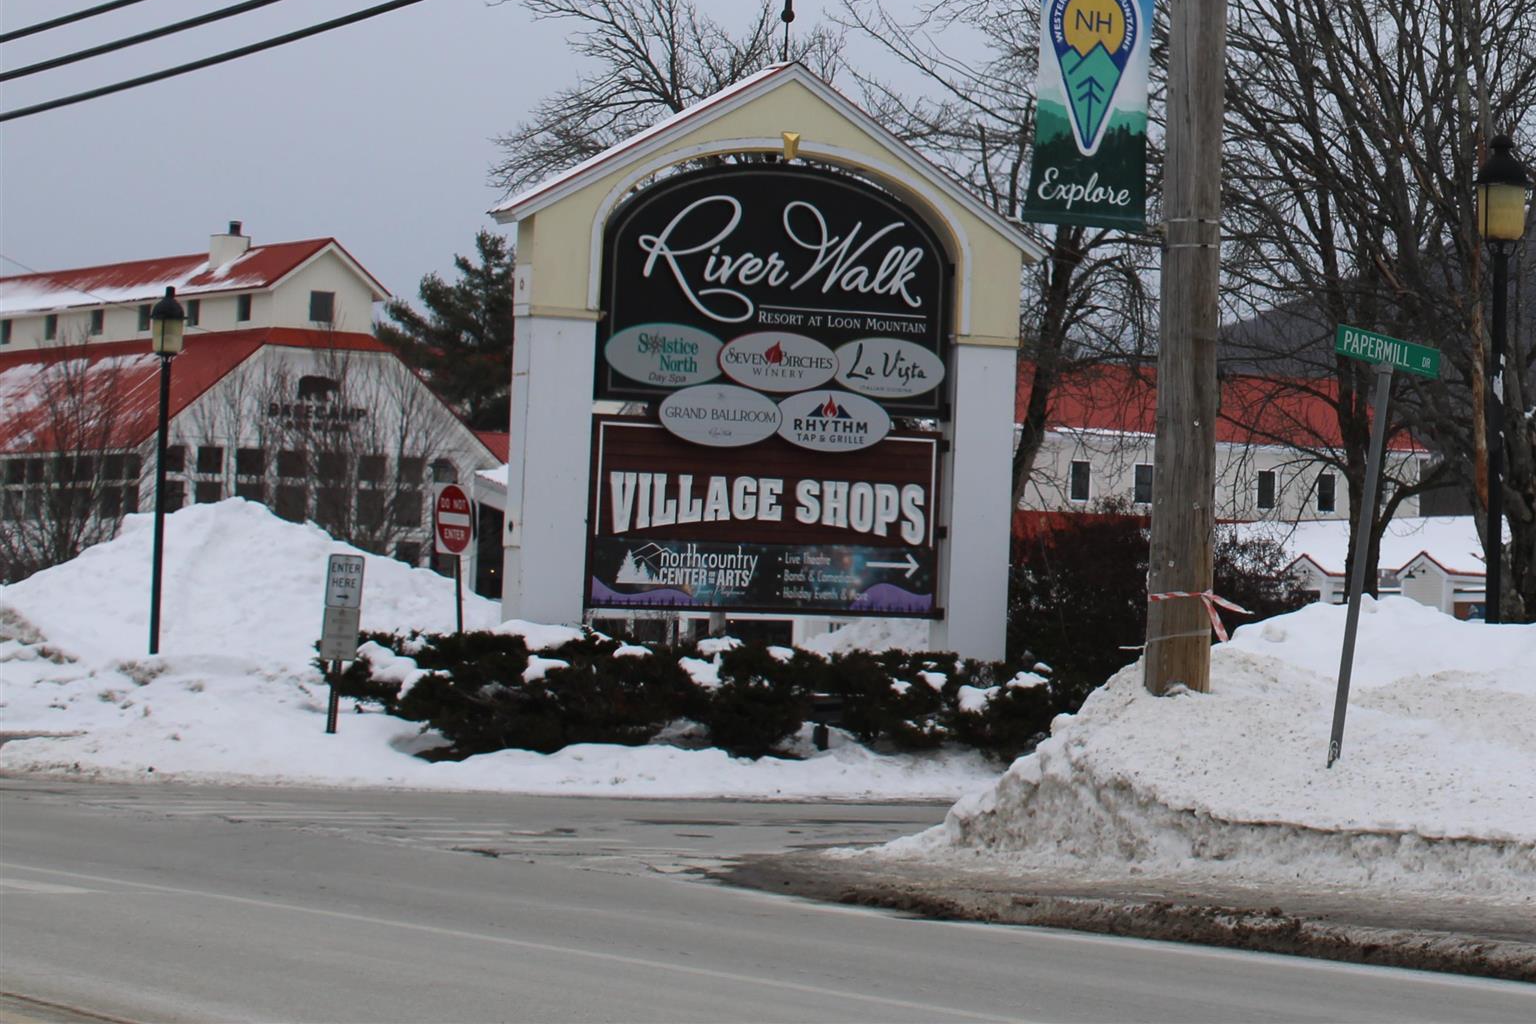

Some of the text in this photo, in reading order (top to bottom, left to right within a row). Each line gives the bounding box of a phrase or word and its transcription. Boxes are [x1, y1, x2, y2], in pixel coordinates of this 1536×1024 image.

[1075, 9, 1112, 34] NH
[1037, 167, 1131, 209] Explore
[639, 194, 923, 323] River Walk
[758, 311, 927, 333] RESORT AT LOON MOUNTAIN
[725, 343, 833, 370] SEVEN BIRCHES
[1343, 330, 1431, 369] PAPERMILL DR
[659, 353, 698, 373] North
[846, 342, 927, 386] La Vista
[648, 371, 687, 384] Day Spa
[752, 367, 804, 379] WINERY
[665, 406, 776, 423] GRAND BALLROOM
[793, 419, 868, 435] RHYTHM
[797, 434, 865, 445] TAP & GRILLE
[440, 497, 466, 510] DO NOT
[610, 471, 925, 546] VILLAGE SHOPS
[444, 528, 465, 540] ENTER
[785, 552, 800, 565] Live
[331, 562, 362, 573] ENTER
[332, 578, 357, 589] HERE
[659, 568, 707, 585] CENTER
[716, 569, 750, 587] ARTS
